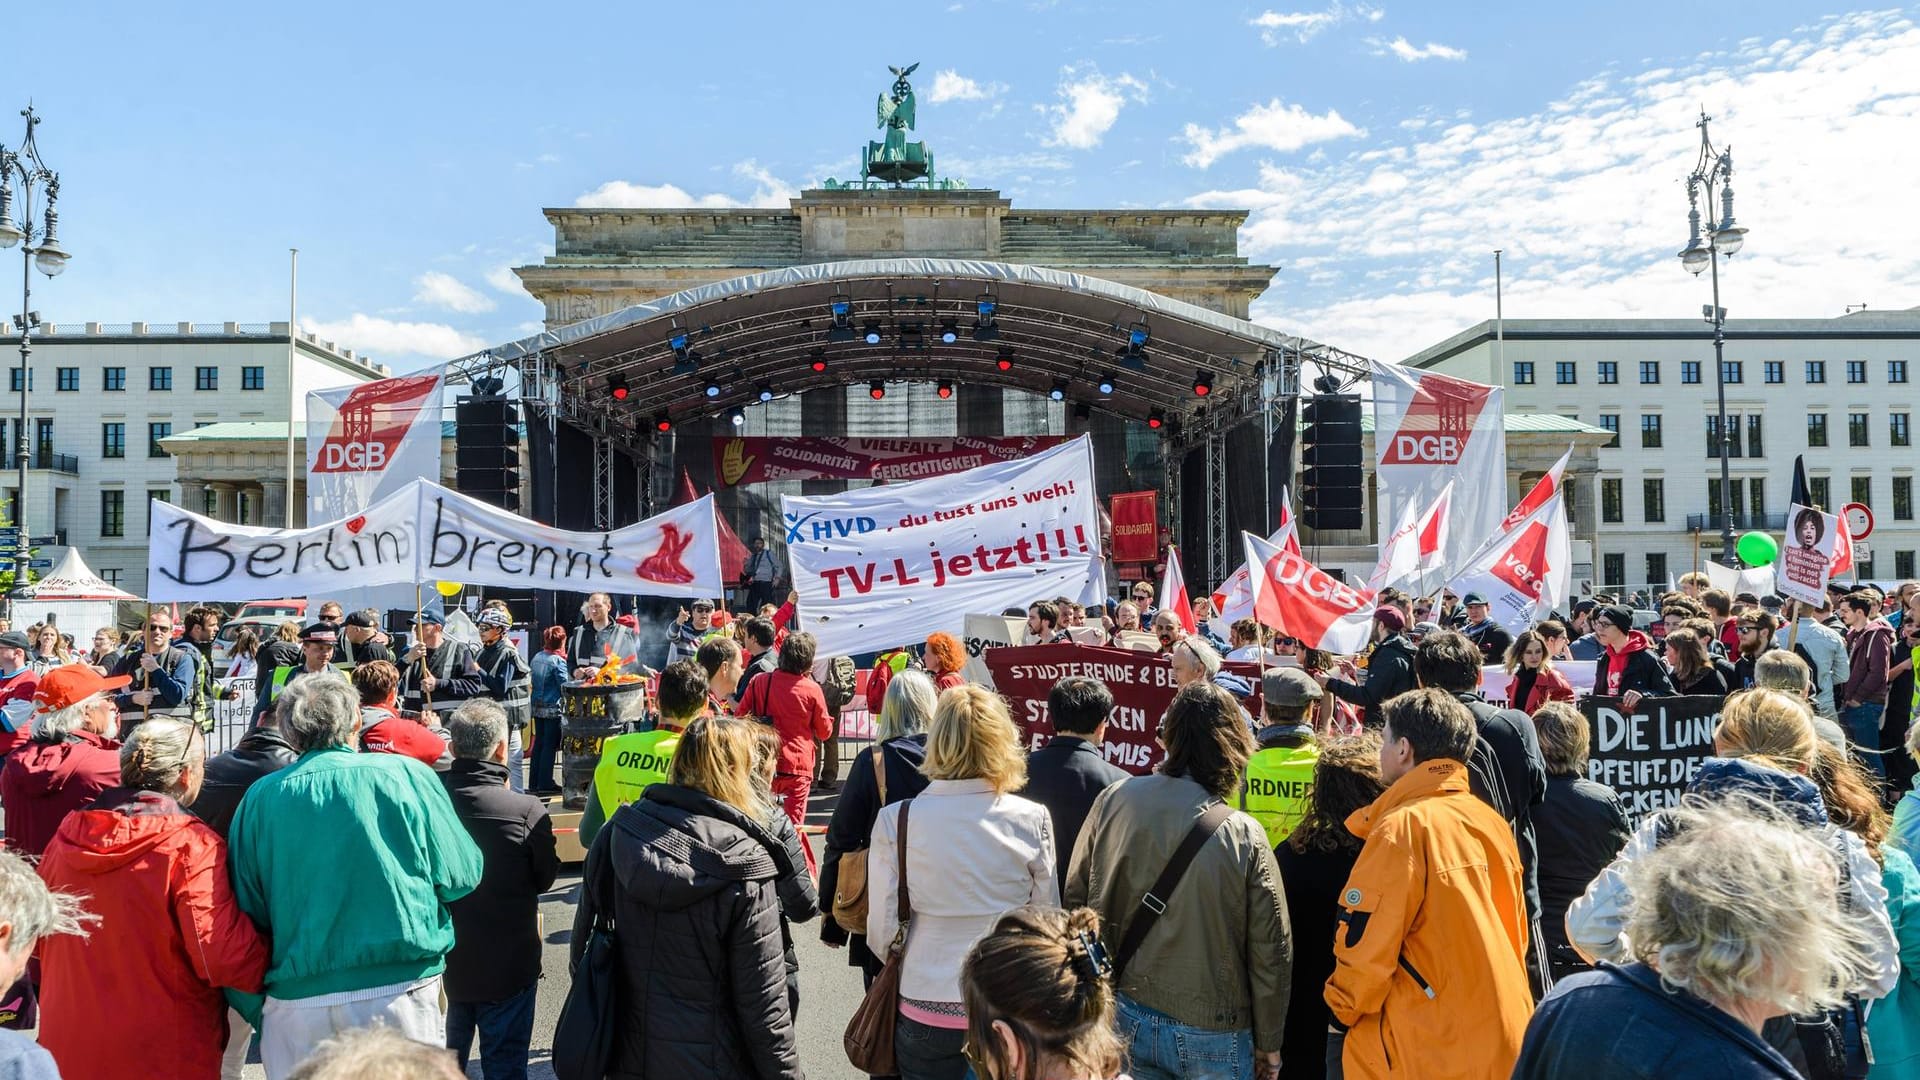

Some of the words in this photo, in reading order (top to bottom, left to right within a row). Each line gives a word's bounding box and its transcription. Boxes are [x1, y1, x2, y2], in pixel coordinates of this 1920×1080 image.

[326, 441, 386, 470] DGB
[773, 446, 860, 472] SOLIDARITÄT
[860, 438, 943, 454] VIELFALT
[1397, 435, 1458, 461] DGB
[870, 454, 983, 480] GERECHTIGKEIT
[812, 515, 877, 541] HVD
[899, 514, 928, 529] du
[933, 504, 976, 523] tust
[981, 493, 1018, 514] uns
[1023, 480, 1076, 504] weh!
[159, 517, 401, 586] Berlin
[428, 497, 614, 580] brennt
[820, 557, 920, 600] TV-L
[930, 524, 1090, 588] jetzt!!!
[1788, 562, 1800, 573] that
[1801, 566, 1807, 574] is
[1807, 569, 1819, 577] not
[1792, 555, 1821, 570] feminism
[1803, 550, 1828, 564] imagine
[1275, 554, 1361, 609] DGB
[1787, 572, 1819, 585] anti-racist
[1010, 662, 1135, 684] STUDIERENDE
[1139, 666, 1151, 684] &
[1155, 667, 1179, 688] BE
[1597, 707, 1650, 752] DIE
[617, 751, 670, 774] ORDN
[1670, 756, 1711, 785] DE
[1245, 778, 1313, 799] RDNE
[1612, 785, 1681, 814] CKEN
